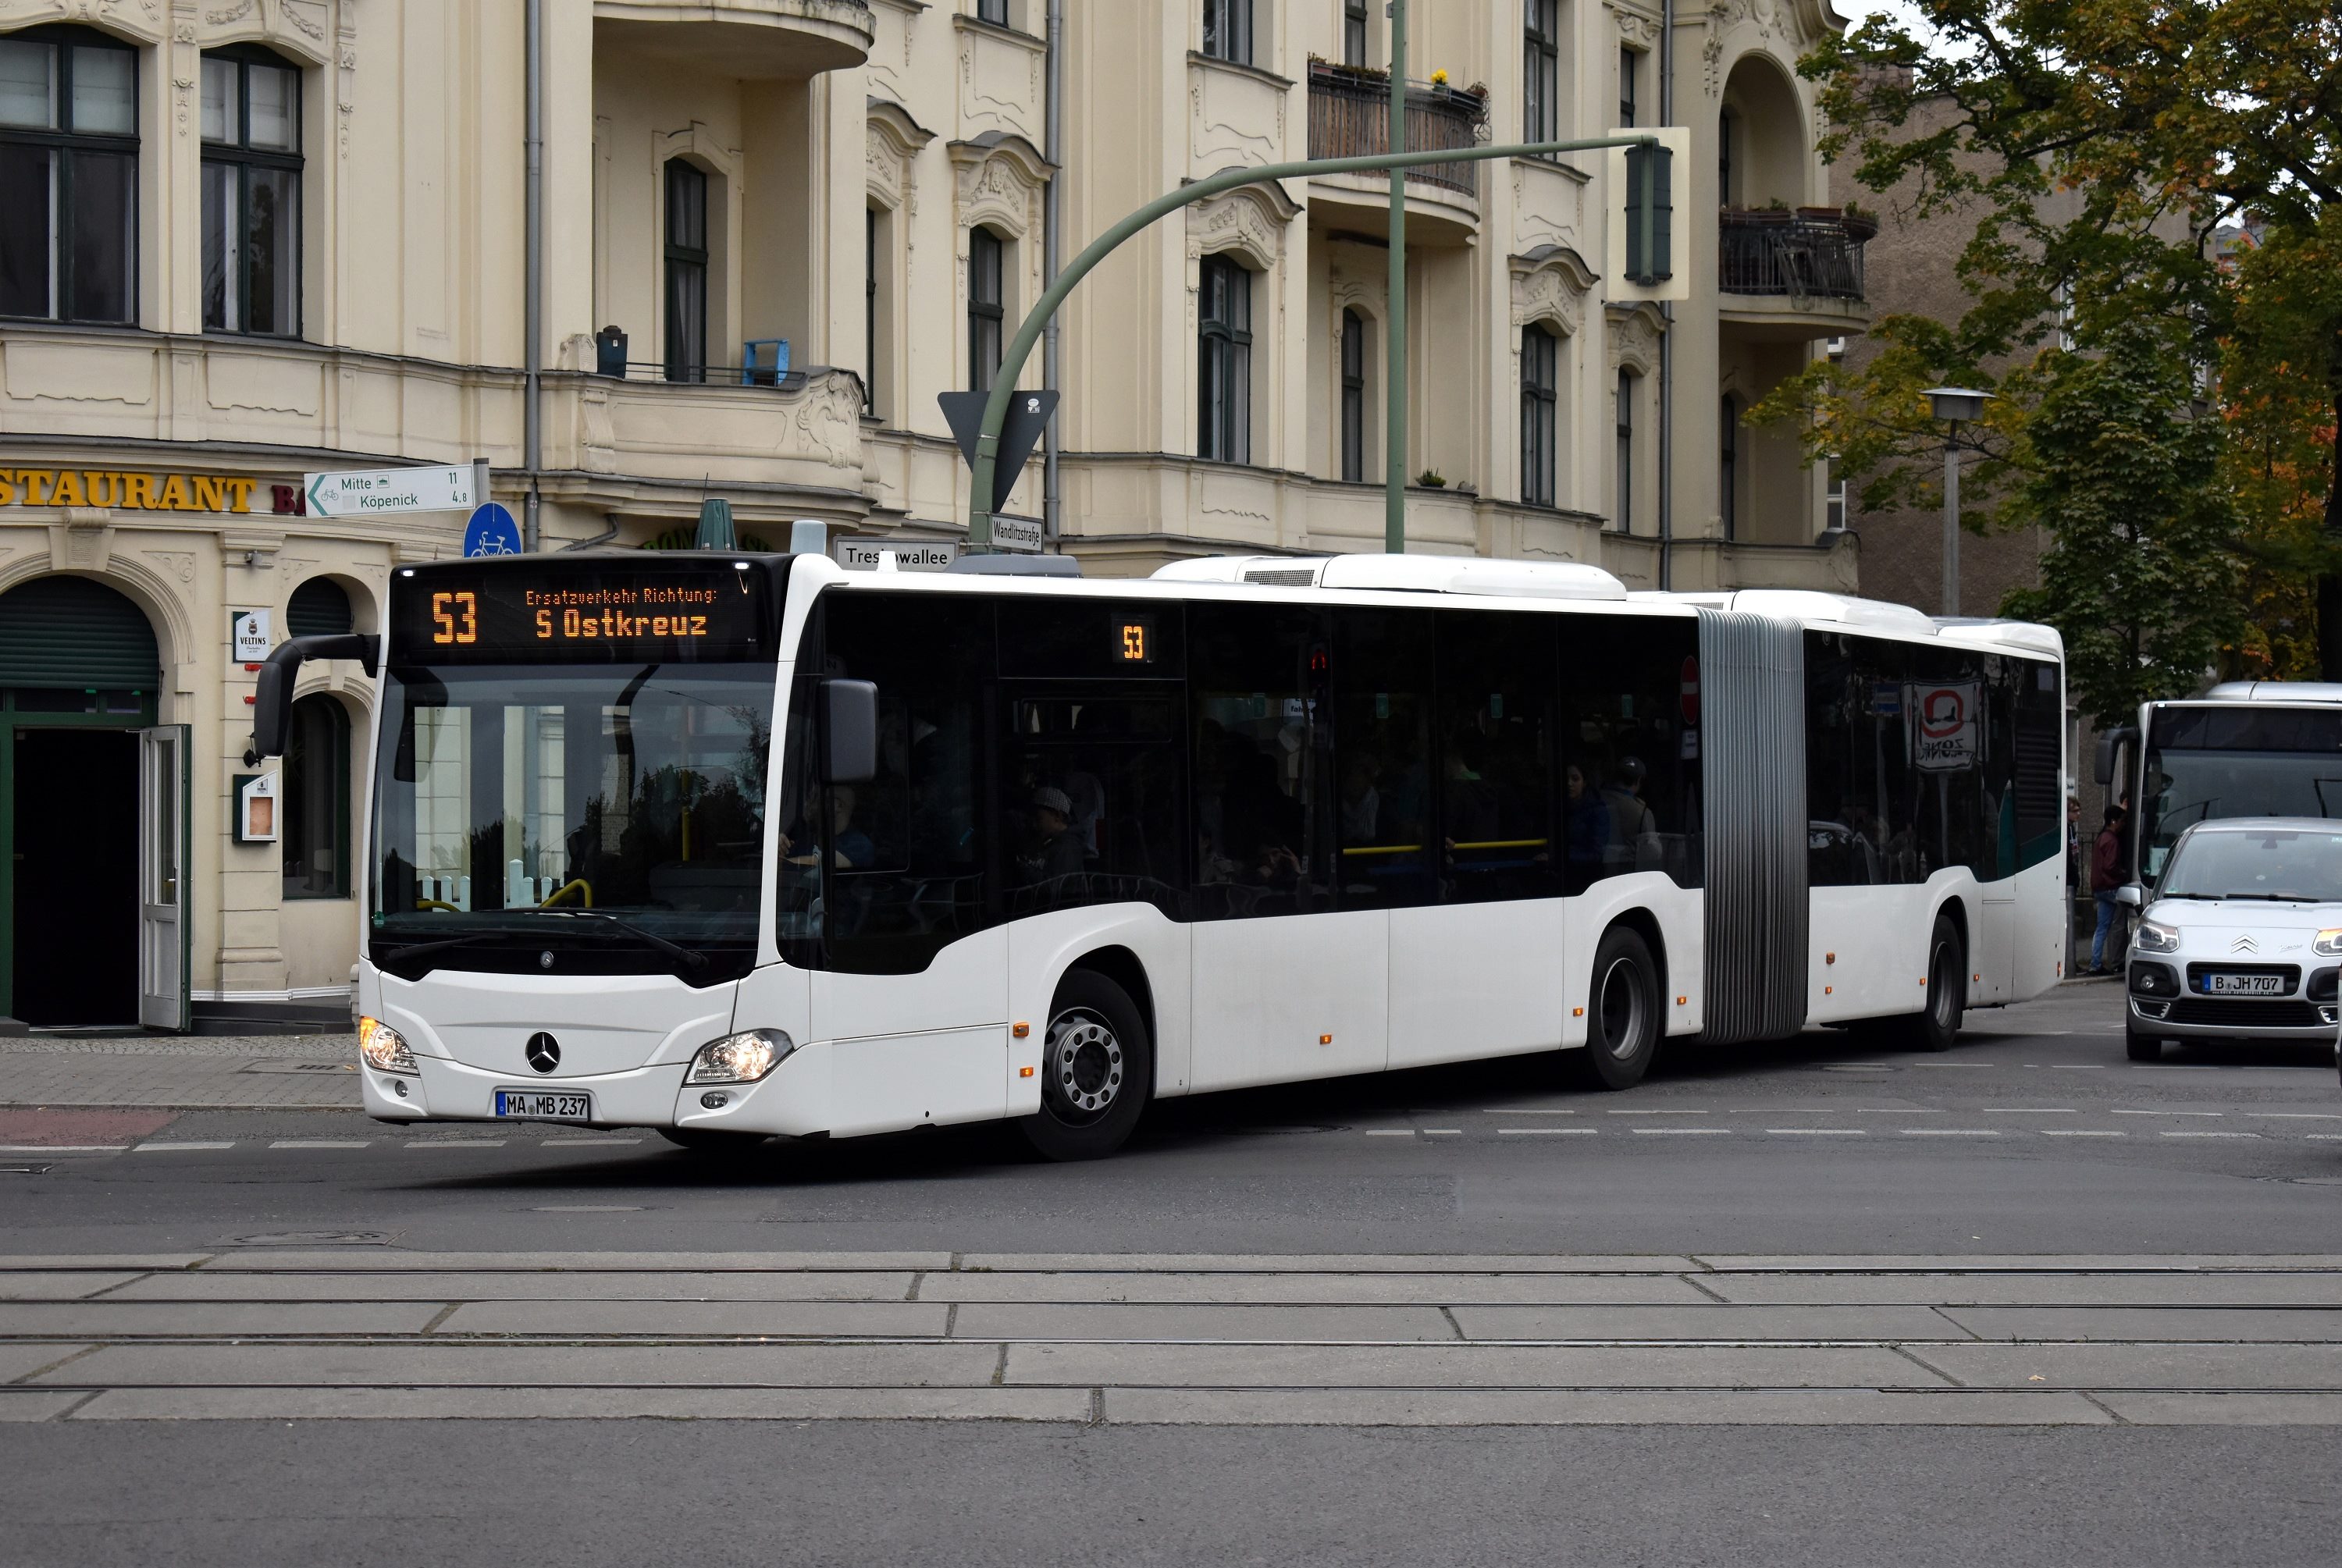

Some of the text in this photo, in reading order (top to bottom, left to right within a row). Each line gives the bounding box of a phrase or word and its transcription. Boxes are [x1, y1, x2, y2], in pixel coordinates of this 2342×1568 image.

[341, 478, 372, 491] Mitte
[448, 471, 457, 485] 11
[360, 493, 418, 510] Köpenick
[993, 521, 1040, 546] Wandlitzstraße
[845, 547, 949, 564] Treswallee
[526, 588, 717, 605] Ersatzverkehr Richtung:
[433, 592, 475, 643] 53
[536, 608, 707, 638] S Ostkreuz
[1123, 625, 1143, 659] 53
[2216, 976, 2279, 990] B JH 707
[507, 1095, 586, 1115] MA MB 237
